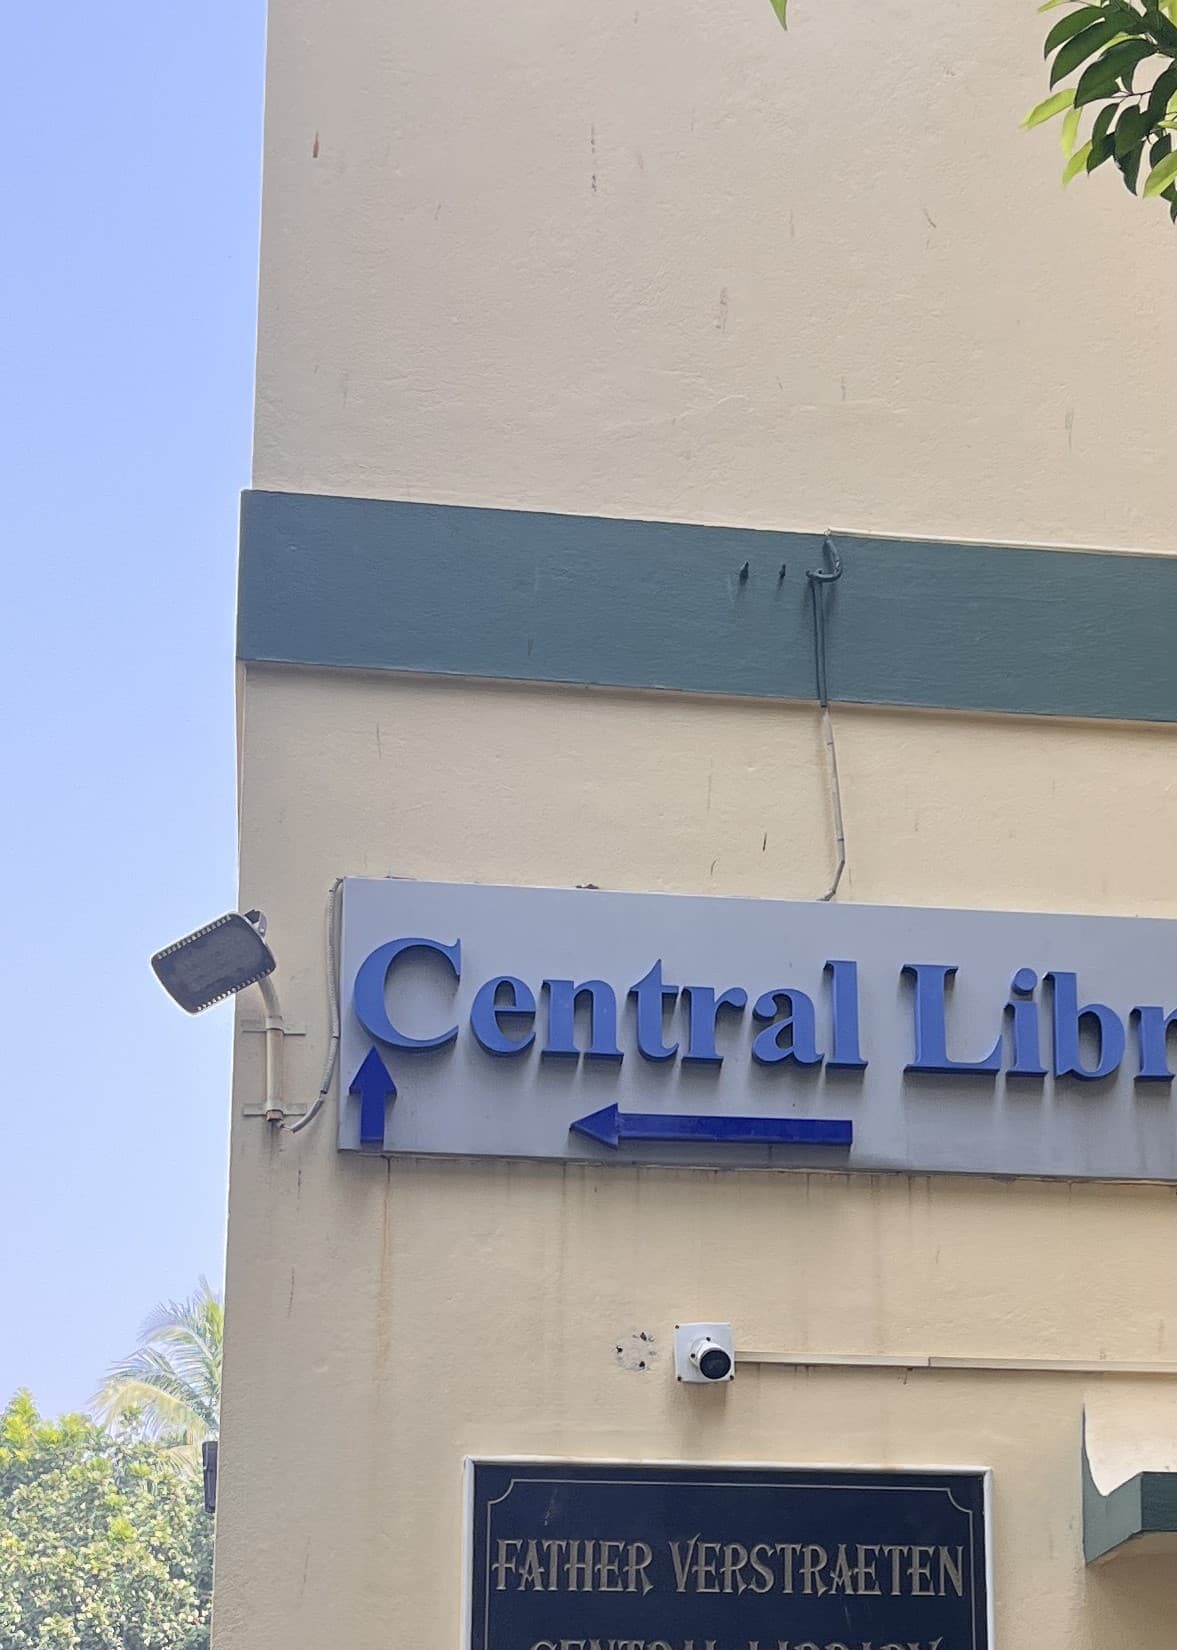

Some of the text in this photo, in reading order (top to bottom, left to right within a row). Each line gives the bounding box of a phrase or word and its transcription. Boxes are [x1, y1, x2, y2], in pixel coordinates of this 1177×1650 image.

[353, 937, 868, 1071] Central
[492, 1533, 965, 1598] FATHER VERSTRAETEN
